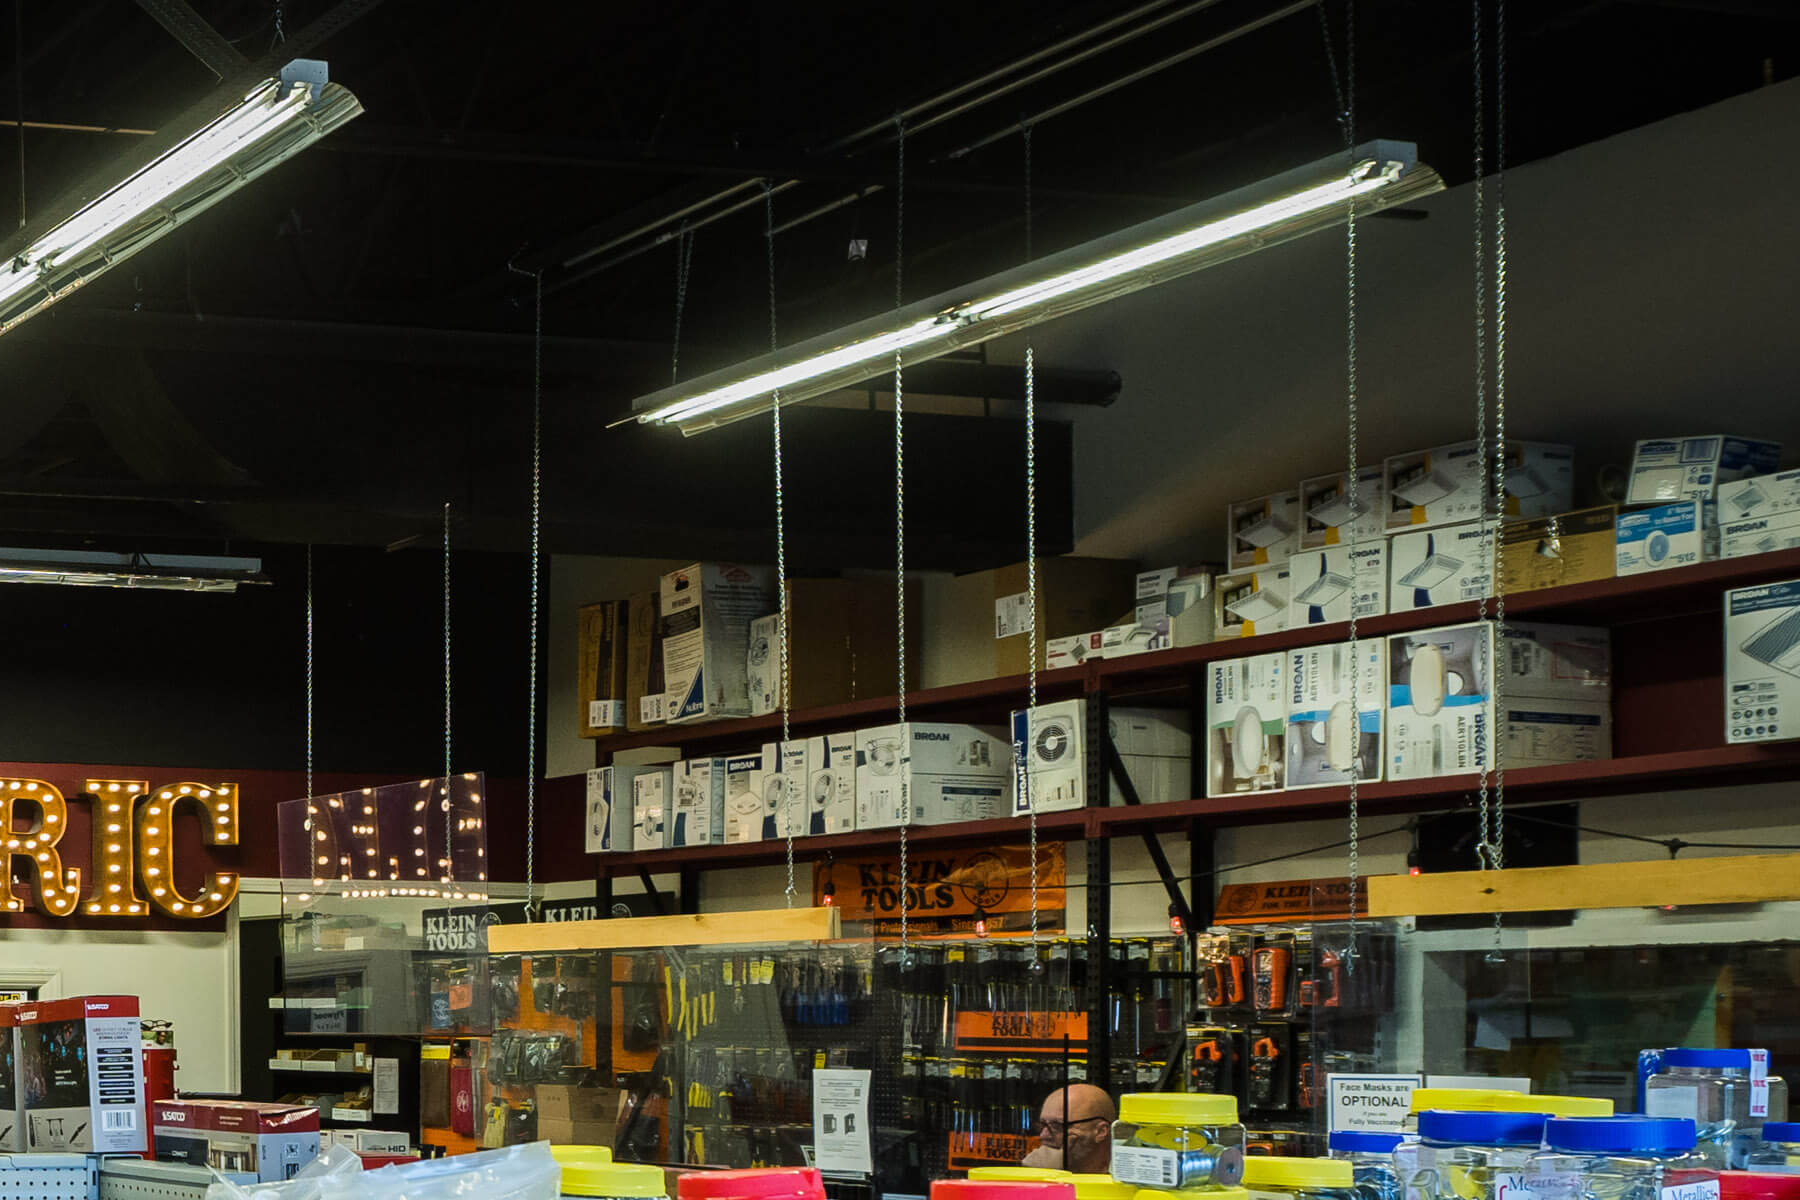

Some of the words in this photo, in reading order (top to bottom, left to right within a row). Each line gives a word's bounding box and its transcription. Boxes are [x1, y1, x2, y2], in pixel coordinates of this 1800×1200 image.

[1726, 520, 1768, 535] BROAN
[1215, 667, 1224, 704] BROAN
[1293, 654, 1304, 704] BROAN
[914, 731, 951, 742] BROAN
[730, 760, 756, 772] BROAN
[1017, 765, 1029, 807] BROAN
[858, 859, 956, 887] KLEIN
[861, 886, 954, 912] TOOLS
[426, 914, 477, 934] KLEIN
[426, 931, 477, 951] TOOLS
[992, 1025, 1032, 1037] TOOLS
[1340, 1083, 1361, 1091] Face
[1363, 1083, 1392, 1092] Masks
[1394, 1084, 1409, 1092] are
[1341, 1095, 1408, 1107] OPTIONAL
[387, 1145, 406, 1153] HID
